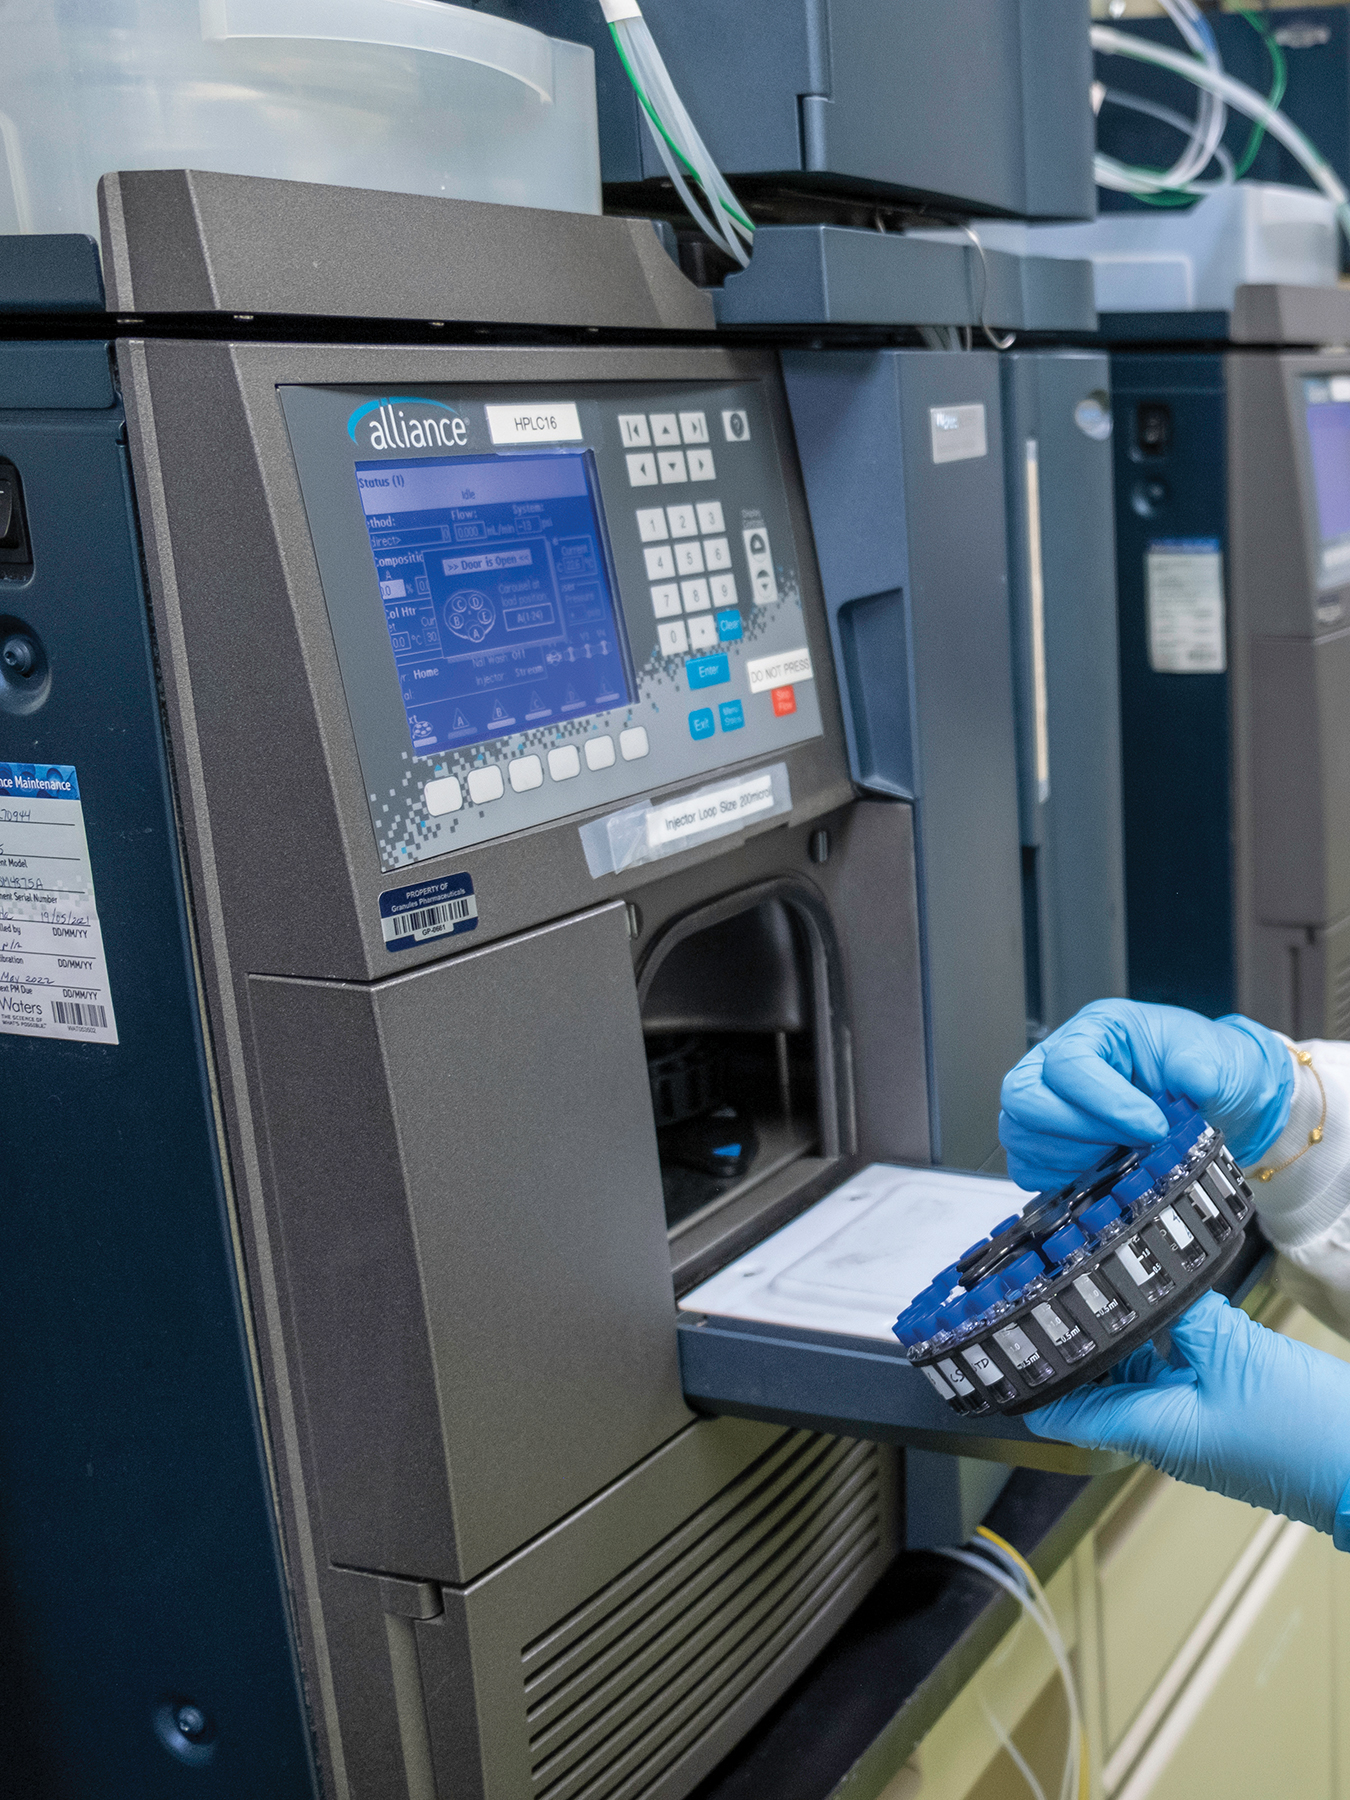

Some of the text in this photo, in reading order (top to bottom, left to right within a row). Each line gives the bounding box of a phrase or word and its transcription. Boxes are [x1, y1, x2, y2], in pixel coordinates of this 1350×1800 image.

[514, 417, 558, 431] HPLC16
[358, 477, 390, 488] Status
[461, 489, 476, 500] Idle
[451, 509, 478, 521] Flow:
[709, 512, 716, 525] 3
[365, 517, 396, 529] thod:
[651, 519, 656, 532] 1
[679, 515, 686, 529] 2
[457, 527, 479, 538] 0.000
[686, 552, 693, 565] 5
[716, 548, 722, 561] 6
[461, 557, 482, 571] Door
[485, 556, 494, 567] is
[495, 553, 518, 567] Open
[657, 556, 664, 569] 4
[693, 589, 699, 603] 8
[722, 584, 728, 597] 9
[664, 594, 669, 608] 7
[401, 606, 417, 619] Htr
[670, 630, 677, 644] 0
[413, 668, 440, 680] Home
[515, 665, 544, 678] Stream
[698, 665, 720, 678] Enter
[751, 658, 810, 683] DO NOT PRESS
[694, 718, 710, 732] Exit
[14, 775, 71, 791] Maintenance
[665, 812, 696, 831] Injector
[698, 806, 717, 820] Loop
[720, 800, 738, 814] Size
[8, 858, 28, 868] Model
[14, 891, 32, 902] Serial
[33, 893, 58, 904] Number
[406, 882, 448, 900] PROPERTY OF
[391, 888, 466, 913] Granules Pharmaceuticals
[52, 927, 88, 939] DD/MM/YY
[57, 958, 93, 970] DD/MM/YY
[20, 985, 33, 995] Due
[62, 988, 98, 1001] DD/MM/YY
[12, 1014, 35, 1022] SCIENCE
